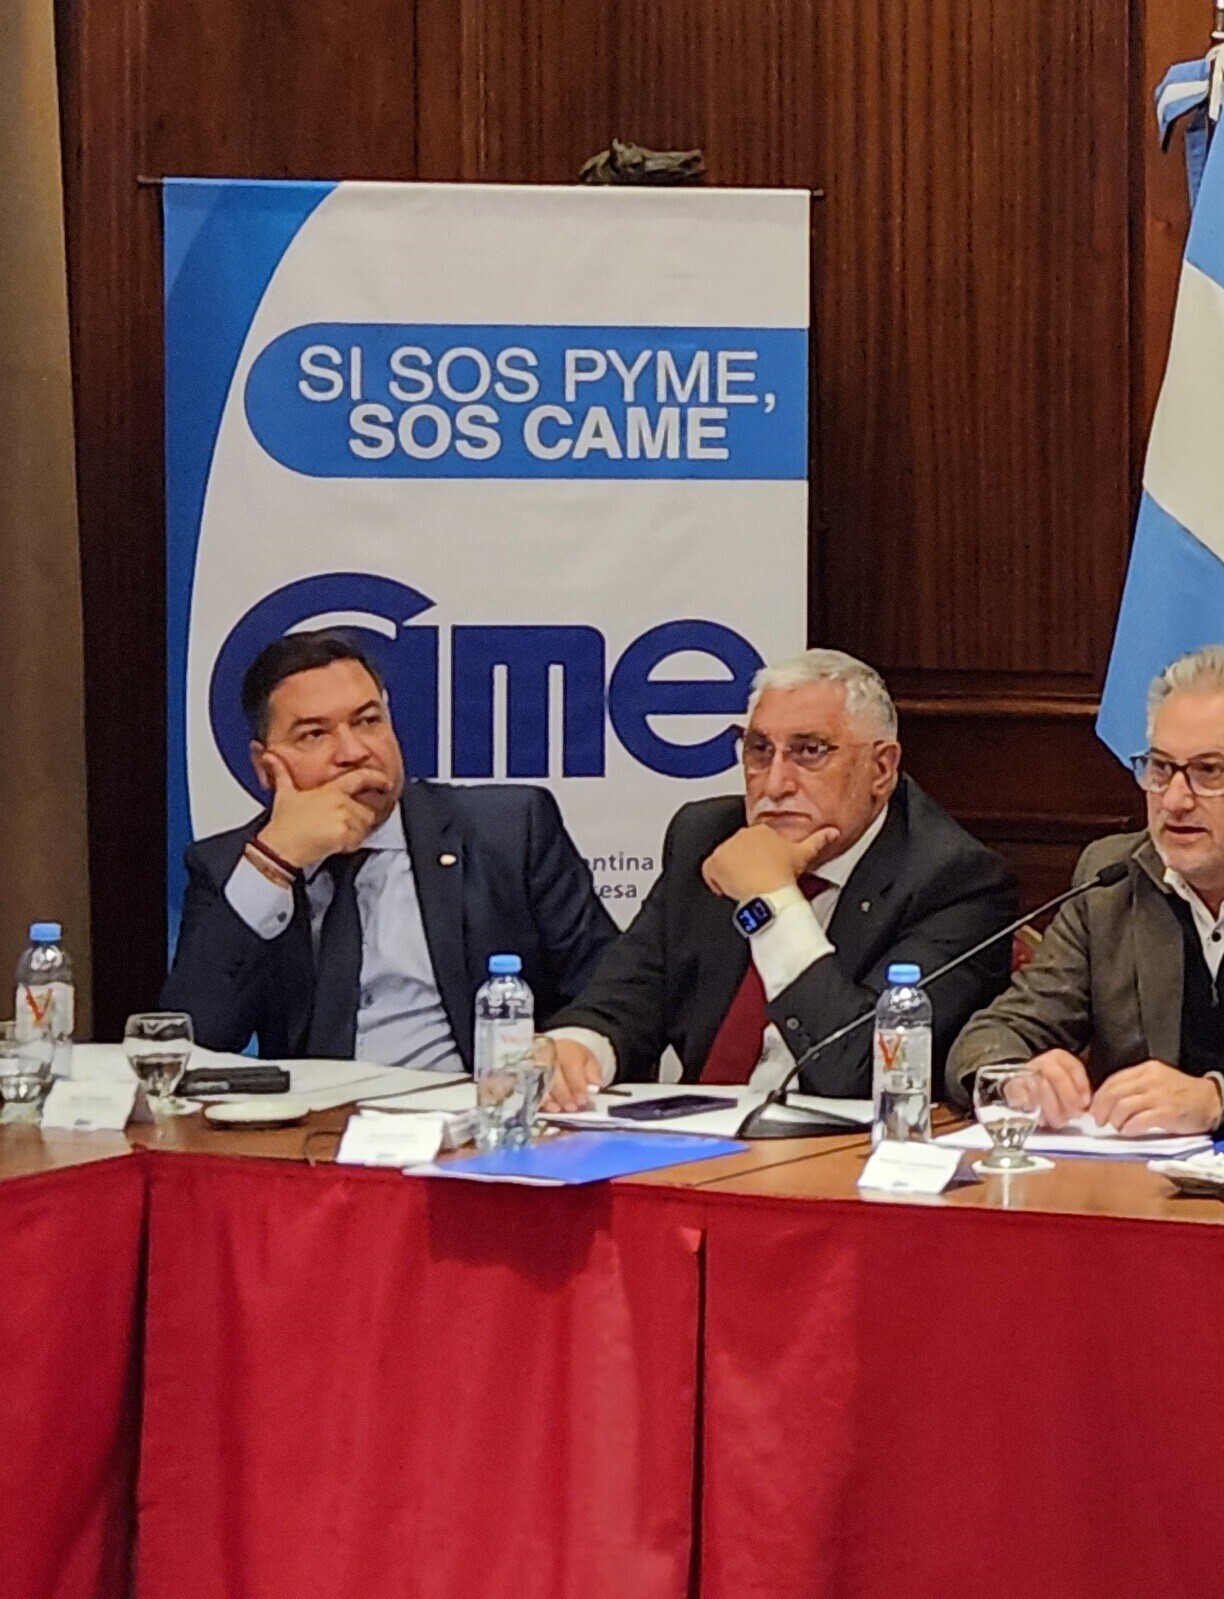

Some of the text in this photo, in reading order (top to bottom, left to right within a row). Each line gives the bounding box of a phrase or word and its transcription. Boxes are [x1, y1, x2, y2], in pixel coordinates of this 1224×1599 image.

[298, 345, 777, 413] SI SOS PYME,
[348, 404, 730, 460] SOS CAME
[586, 851, 655, 871] ntina
